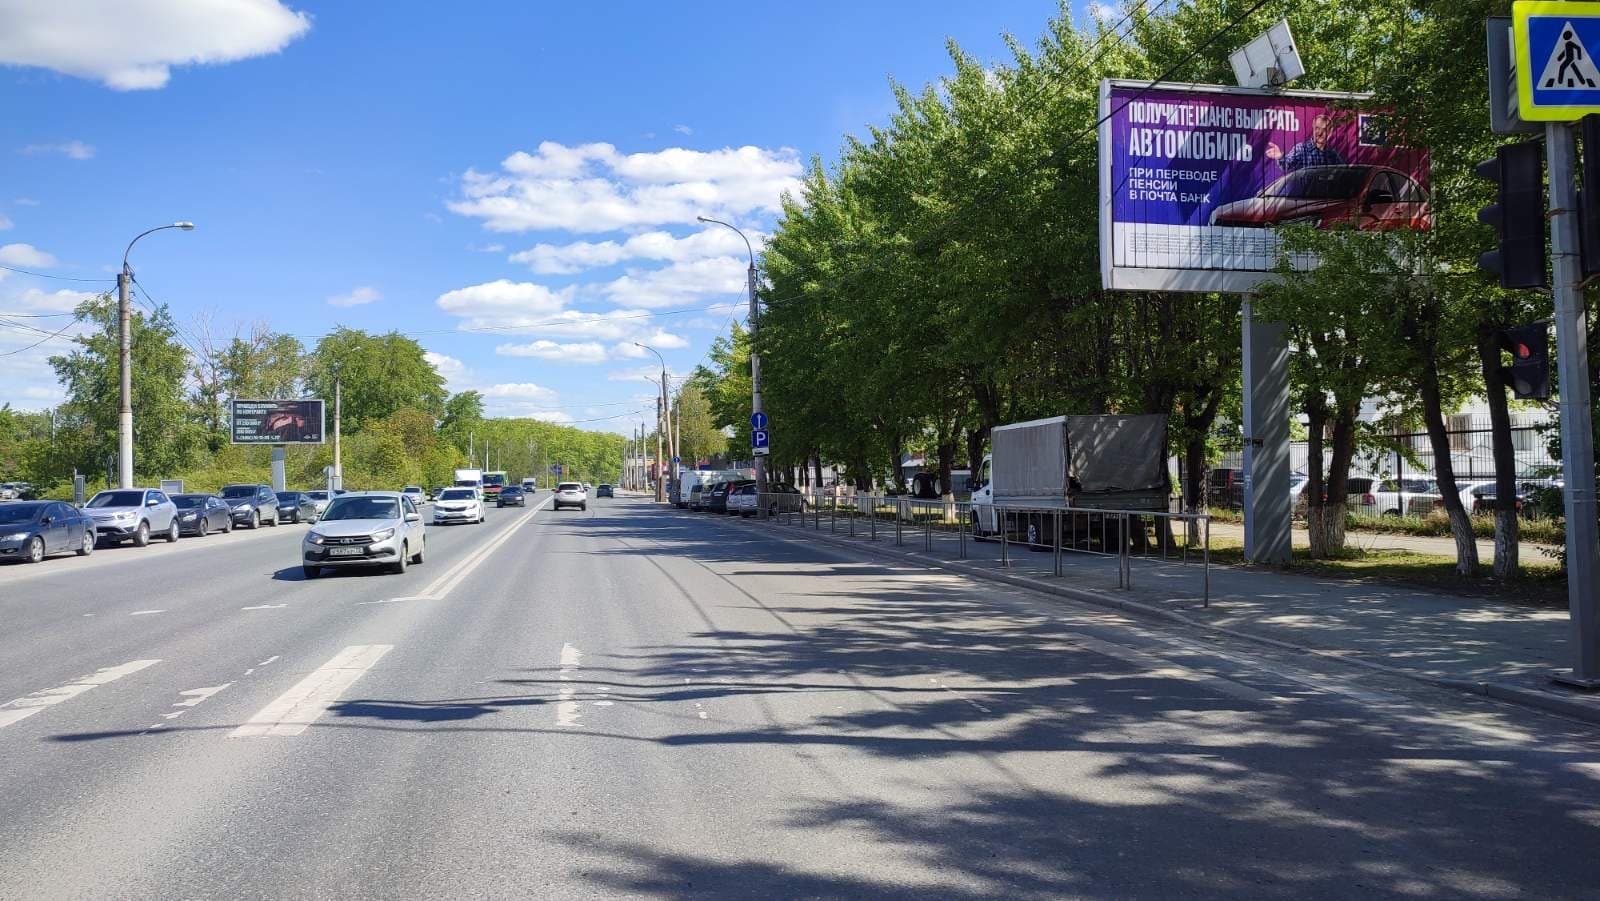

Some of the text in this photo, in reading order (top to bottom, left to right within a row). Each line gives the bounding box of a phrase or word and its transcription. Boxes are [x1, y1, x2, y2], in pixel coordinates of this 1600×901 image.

[1129, 102, 1299, 131] ПОЛУЧИТЕ ШАНС ВЫИГРАТЬ
[1129, 128, 1252, 161] АВТОМОБИЛЬ
[1129, 167, 1218, 182] ПРИ ПЕРЕВОДЕ
[1129, 179, 1178, 191] ПЕНСИИ
[1129, 190, 1210, 204] В ПОЧТА БАНК
